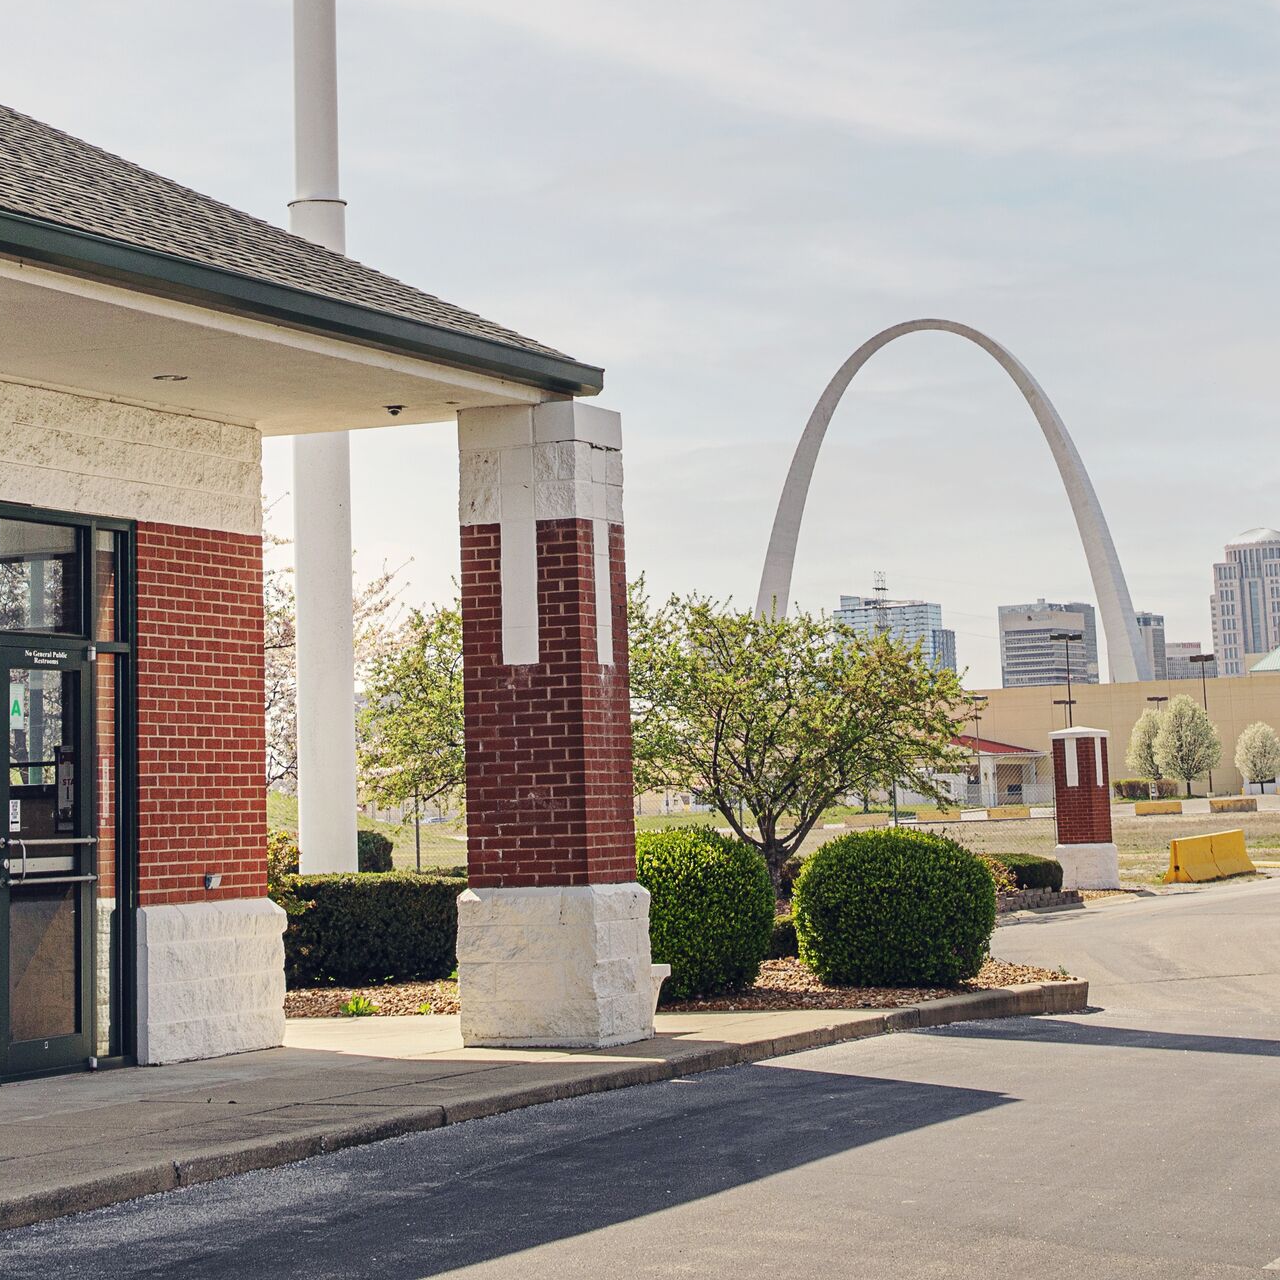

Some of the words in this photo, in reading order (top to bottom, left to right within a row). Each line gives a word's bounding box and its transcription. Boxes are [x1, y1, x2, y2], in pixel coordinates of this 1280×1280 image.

[24, 649, 33, 657] No
[32, 650, 52, 658] General
[52, 651, 68, 659] Public
[33, 657, 59, 665] Restrooms
[10, 699, 22, 717] A
